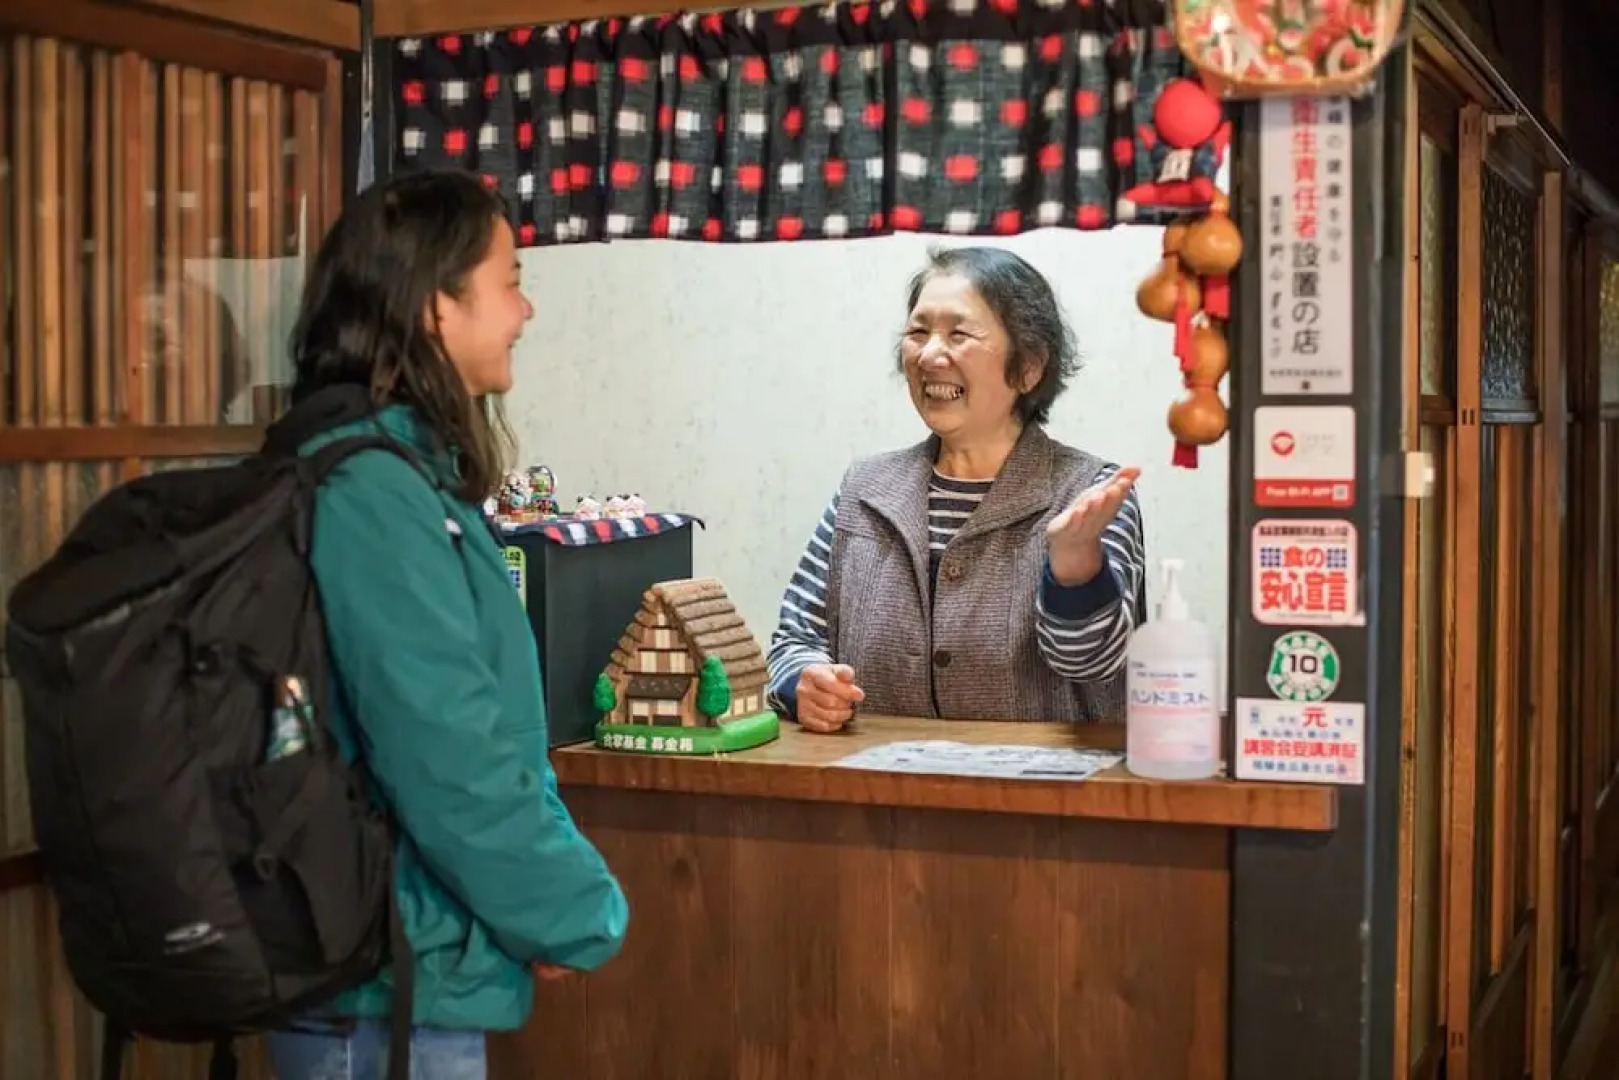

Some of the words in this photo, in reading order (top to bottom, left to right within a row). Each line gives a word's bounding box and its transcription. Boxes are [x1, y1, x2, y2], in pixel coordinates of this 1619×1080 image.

[1283, 545, 1325, 568] 食の
[1260, 570, 1347, 612] 安心宣言
[1290, 653, 1317, 673] 10
